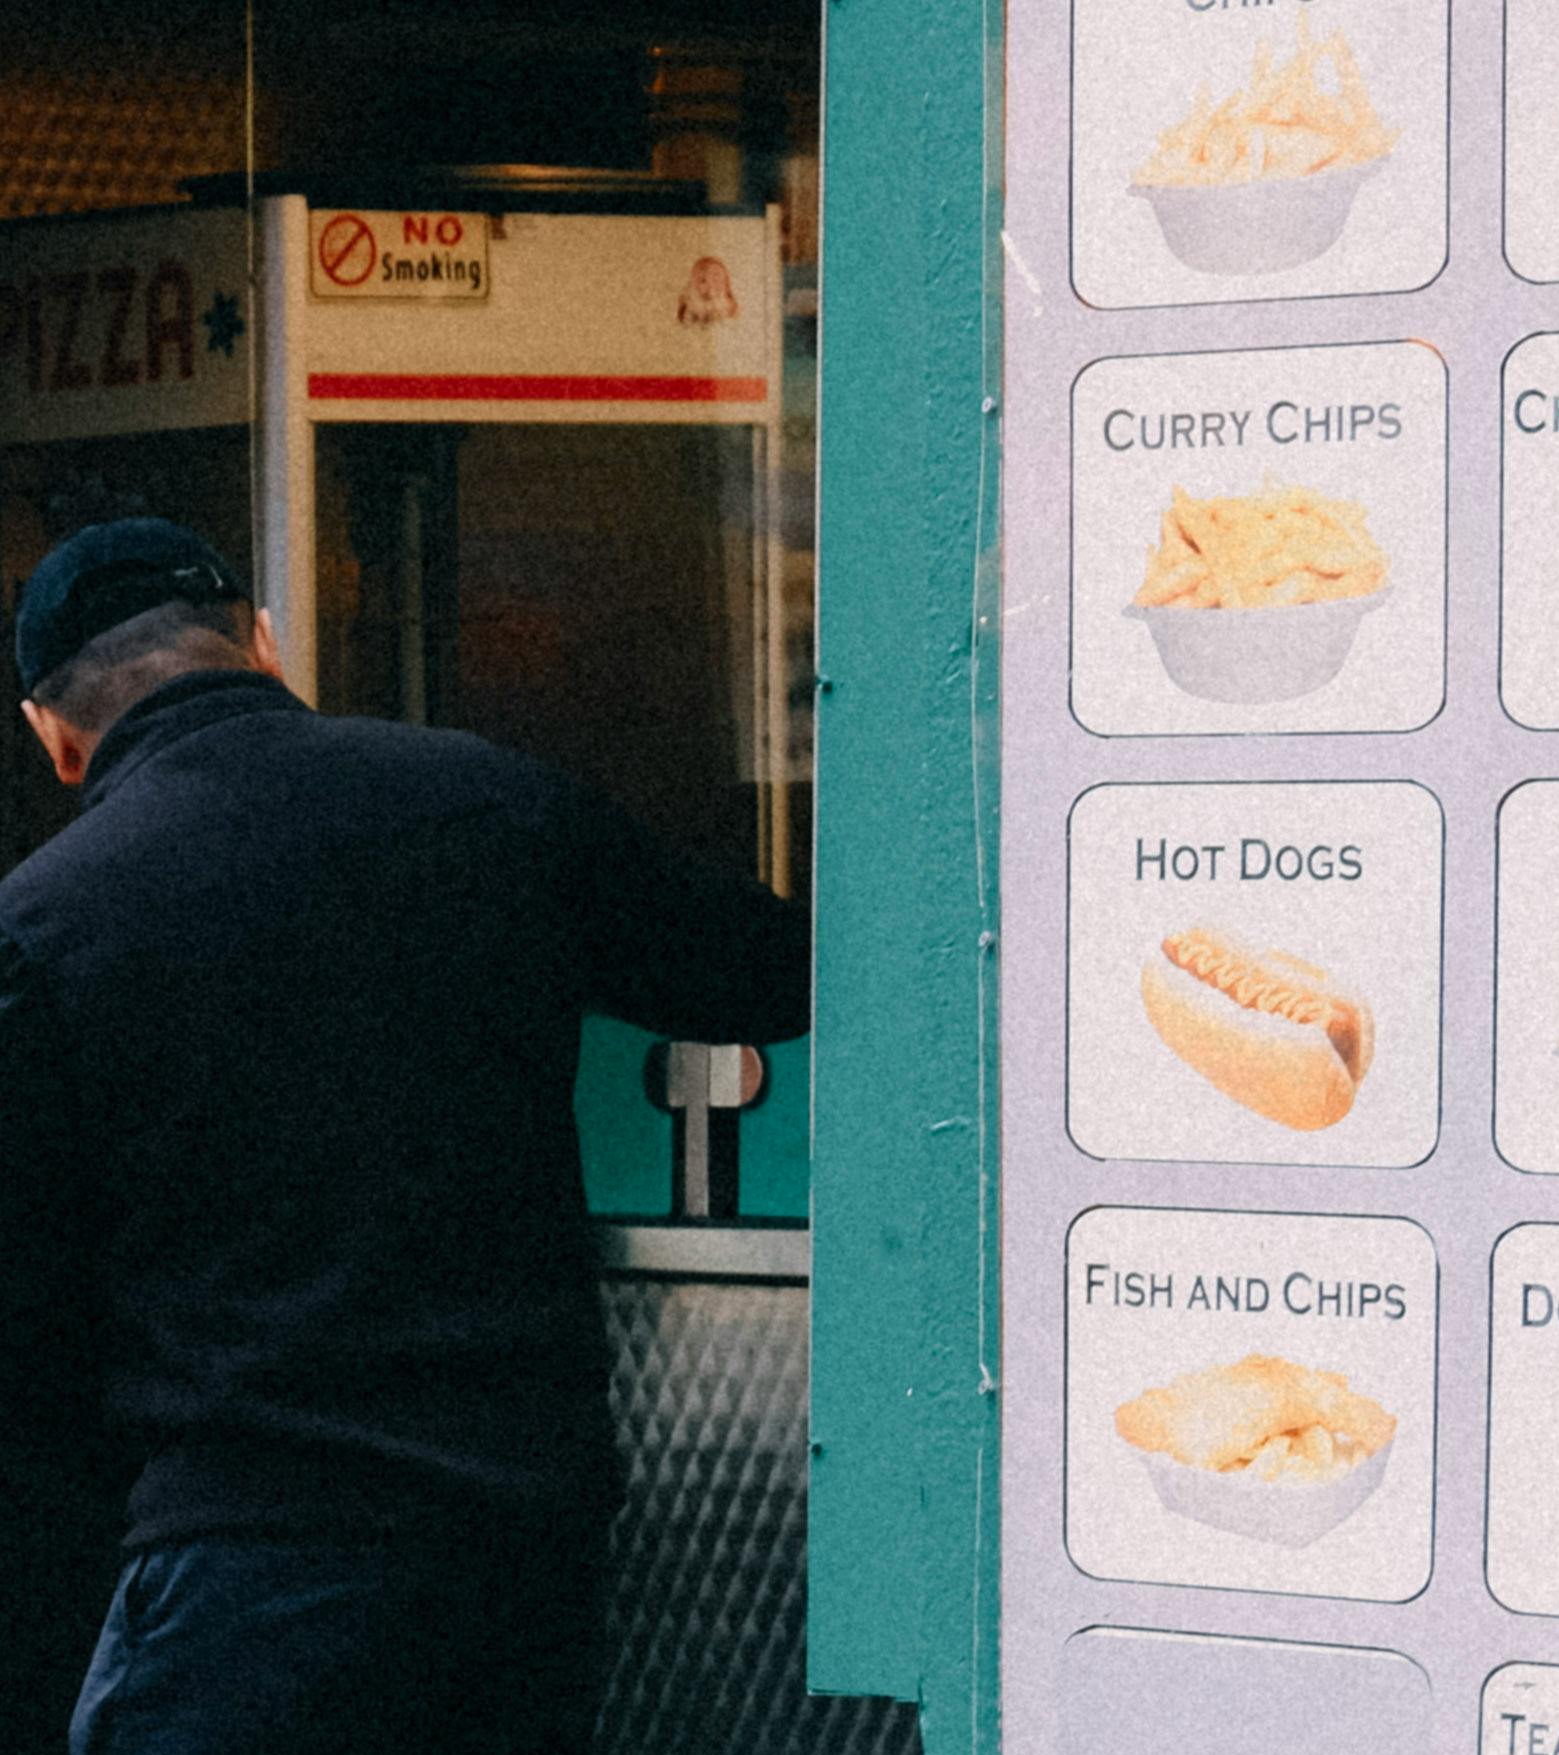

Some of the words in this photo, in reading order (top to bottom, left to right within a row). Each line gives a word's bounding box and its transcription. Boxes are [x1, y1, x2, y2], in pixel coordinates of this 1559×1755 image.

[404, 216, 462, 246] NO
[382, 252, 481, 289] Smoking
[1103, 408, 1252, 450] CURRY
[1266, 401, 1404, 446] CHIPS
[1136, 838, 1225, 880] HOT
[1240, 838, 1363, 880] DOGS
[1085, 1264, 1173, 1308] FISH
[1187, 1275, 1269, 1312] AND
[1284, 1272, 1407, 1320] CHIPS
